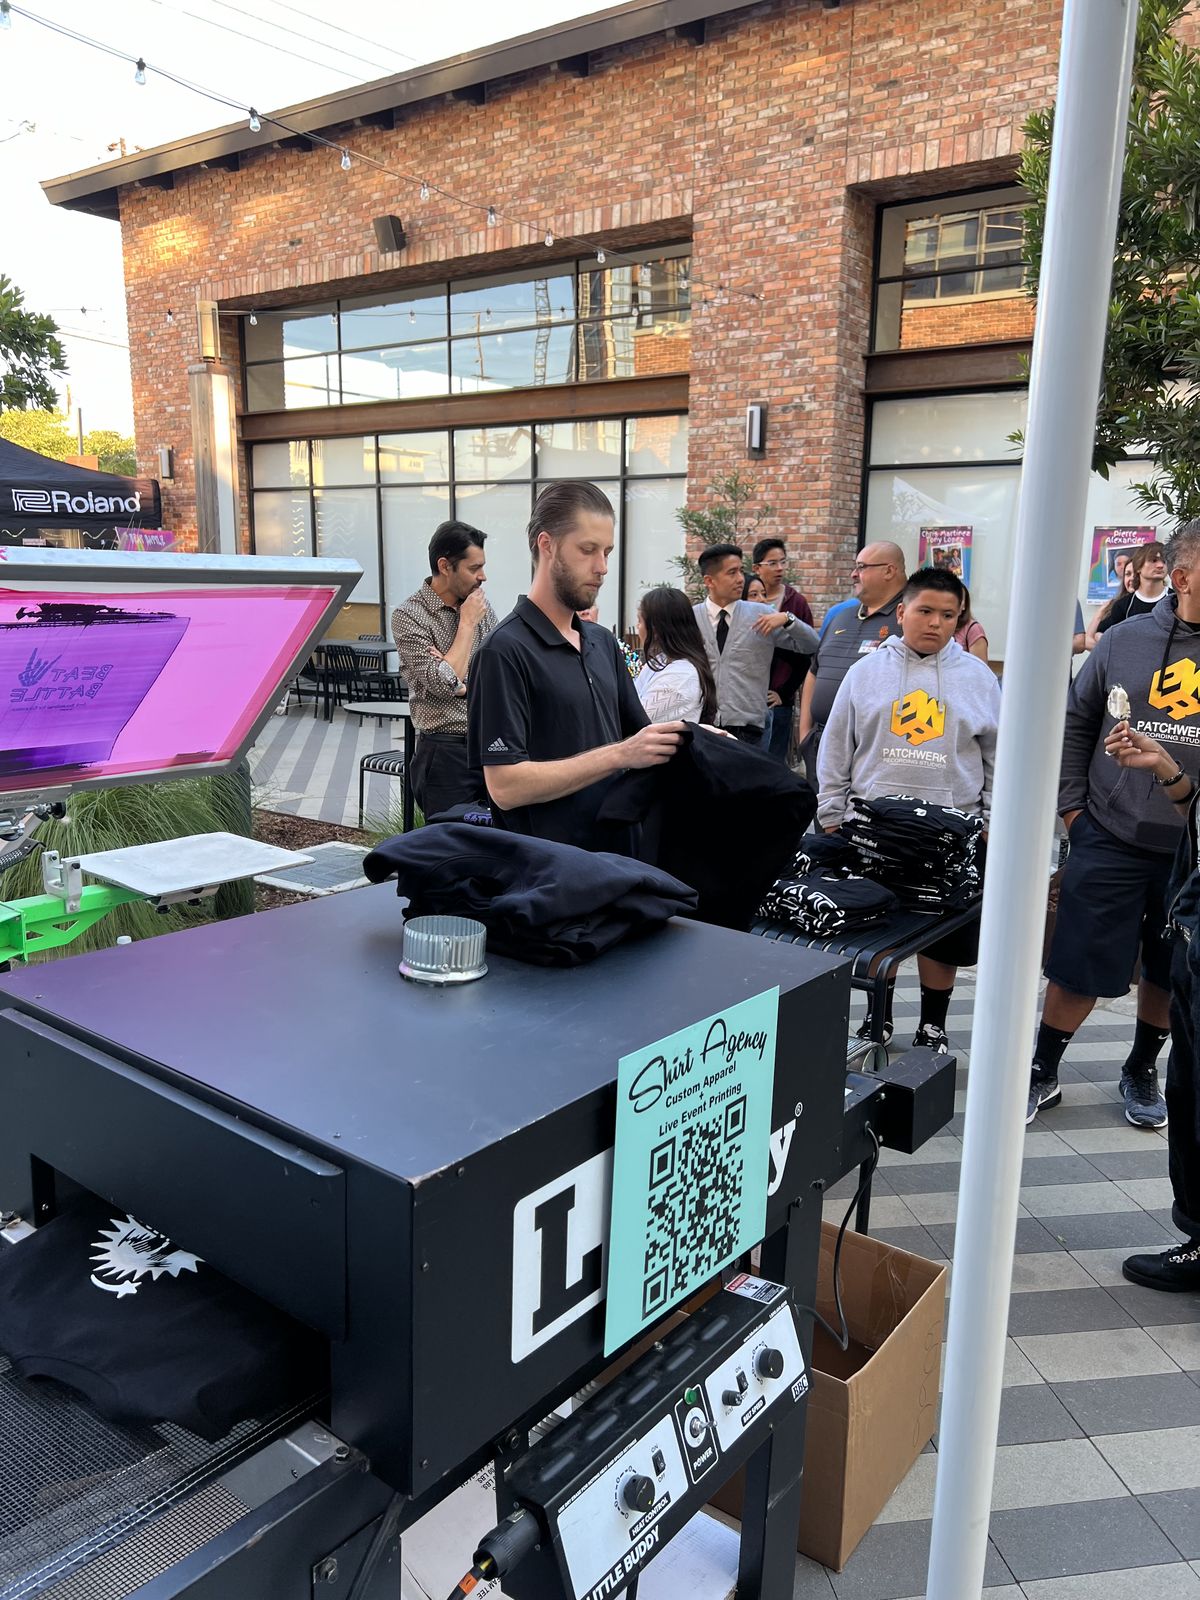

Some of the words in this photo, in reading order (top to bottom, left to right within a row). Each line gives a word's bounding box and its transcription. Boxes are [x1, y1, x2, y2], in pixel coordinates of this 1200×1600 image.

[51, 491, 140, 513] Roland
[1113, 529, 1138, 537] Pierre
[882, 748, 948, 763] PATCHWERK
[628, 1047, 695, 1114] Shirt
[699, 1018, 767, 1064] Agency
[665, 1082, 701, 1108] Custom
[703, 1060, 736, 1088] Apparel
[658, 1118, 679, 1137] Live
[681, 1103, 707, 1124] Event
[709, 1082, 742, 1108] Printing
[693, 1449, 713, 1471] POWER
[631, 1519, 646, 1535] HEAT
[644, 1497, 669, 1522] CONTROL
[623, 1525, 661, 1574] BUDDY
